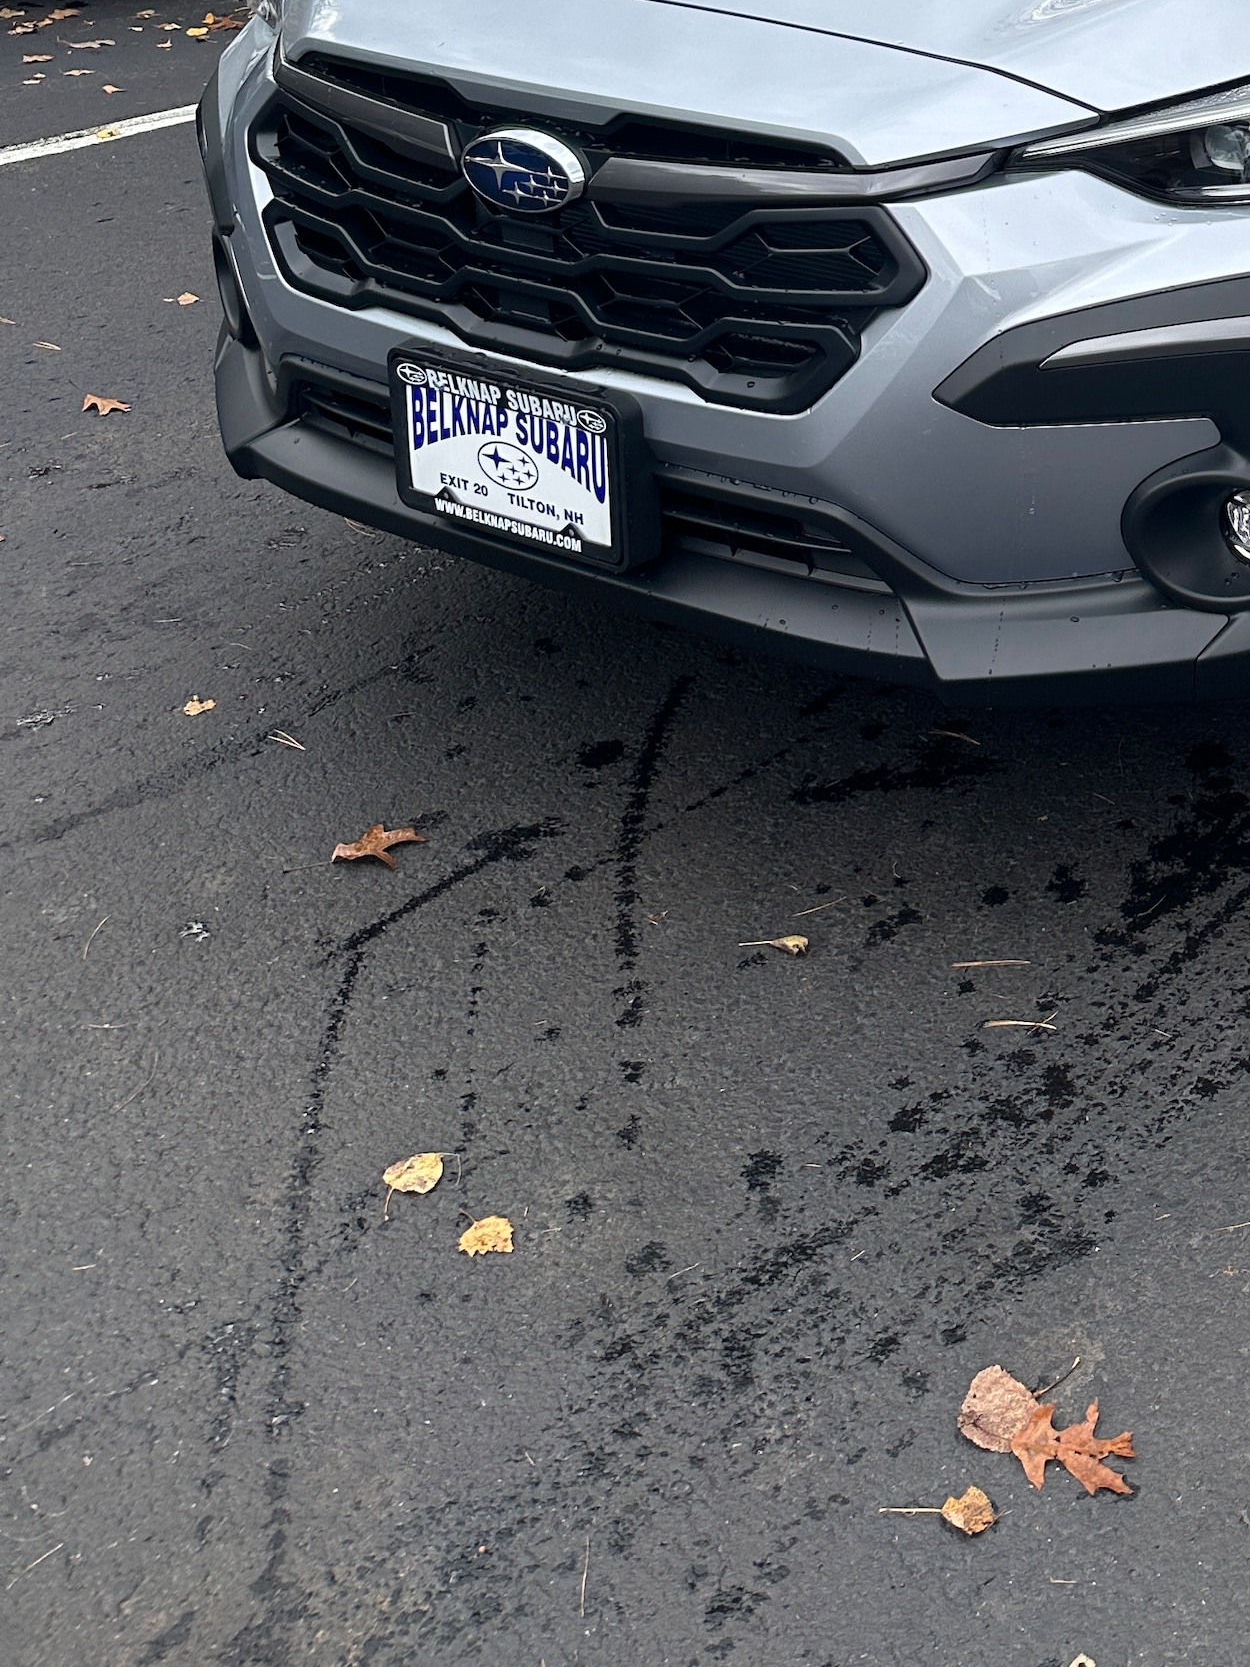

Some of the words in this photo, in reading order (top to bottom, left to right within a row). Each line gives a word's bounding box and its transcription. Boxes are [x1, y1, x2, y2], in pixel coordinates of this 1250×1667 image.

[425, 368, 502, 406] BELKNAP
[506, 389, 578, 427] SUBARU
[411, 385, 509, 451] BELKNAP
[515, 411, 607, 505] SUBARU
[439, 472, 469, 491] EXIT
[473, 483, 489, 497] 20
[507, 492, 560, 520] TILTON,
[564, 508, 584, 526] NH
[434, 497, 583, 553] WWW.BELKNAPSUBARU.COM
